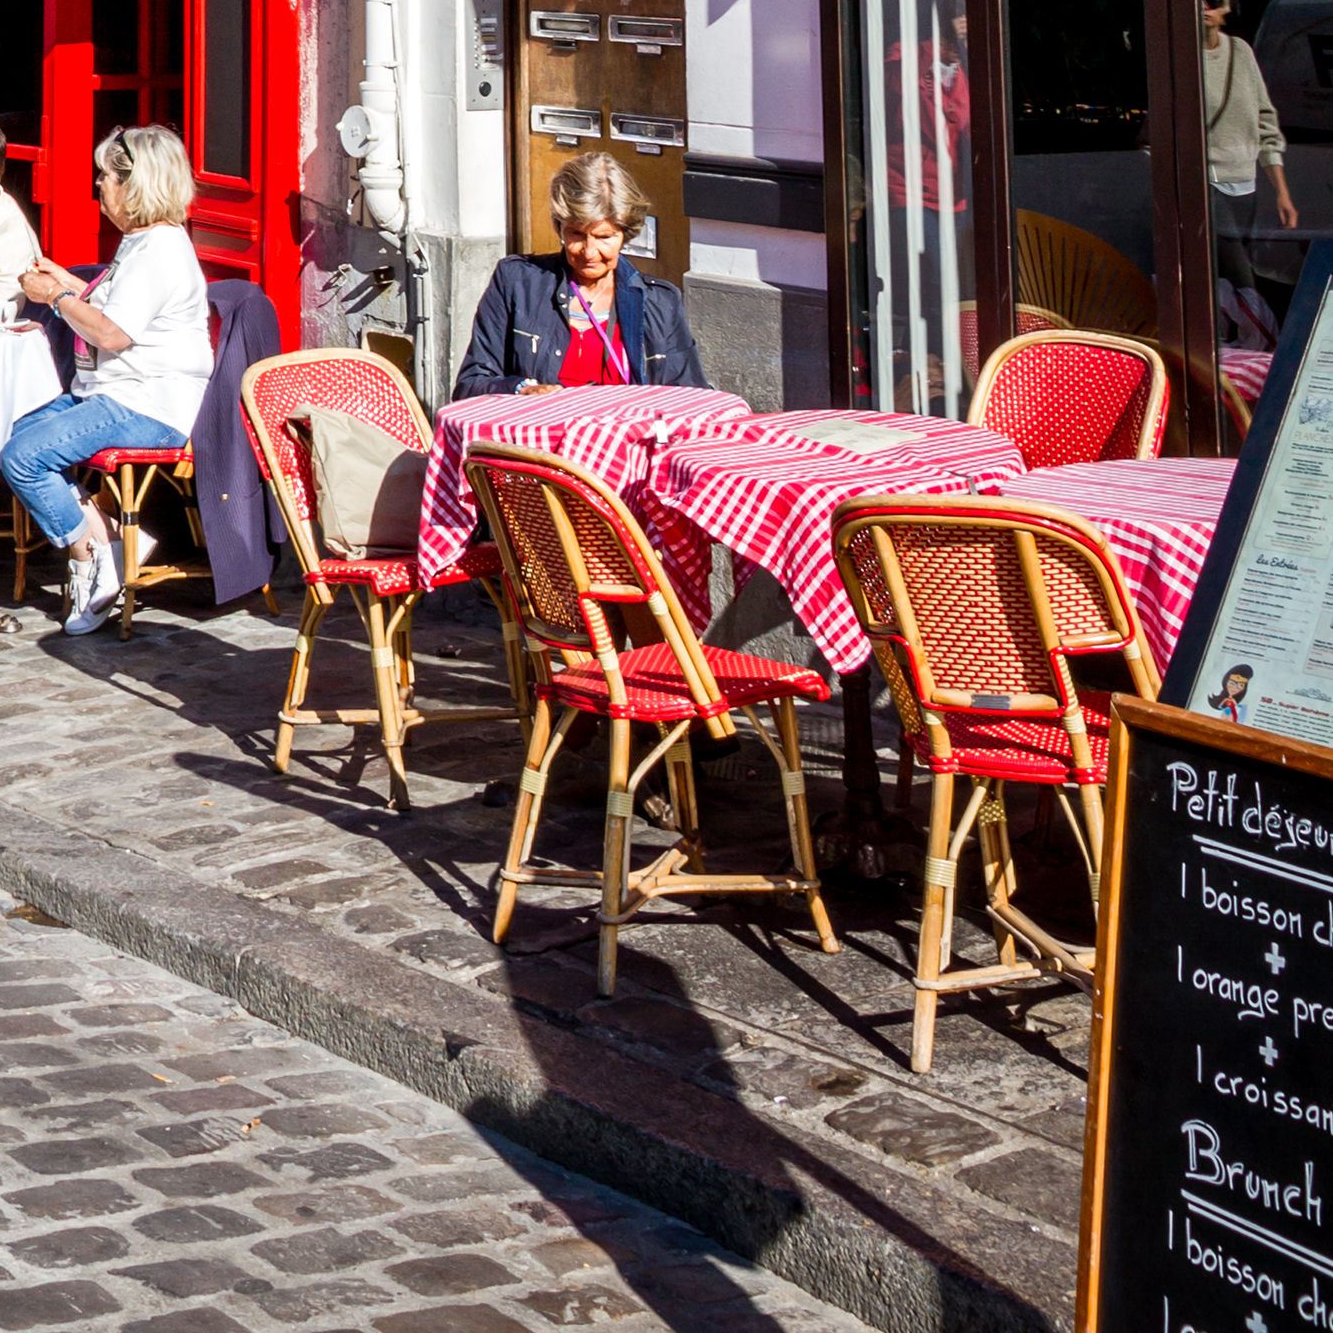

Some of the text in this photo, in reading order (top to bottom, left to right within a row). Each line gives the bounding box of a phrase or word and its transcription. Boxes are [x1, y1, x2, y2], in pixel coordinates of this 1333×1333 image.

[1166, 761, 1333, 852] Petit déjeu
[1202, 867, 1302, 939] boisson
[1193, 968, 1279, 1021] orange
[1181, 1119, 1322, 1227] Brunch
[1186, 1217, 1284, 1310] boisson
